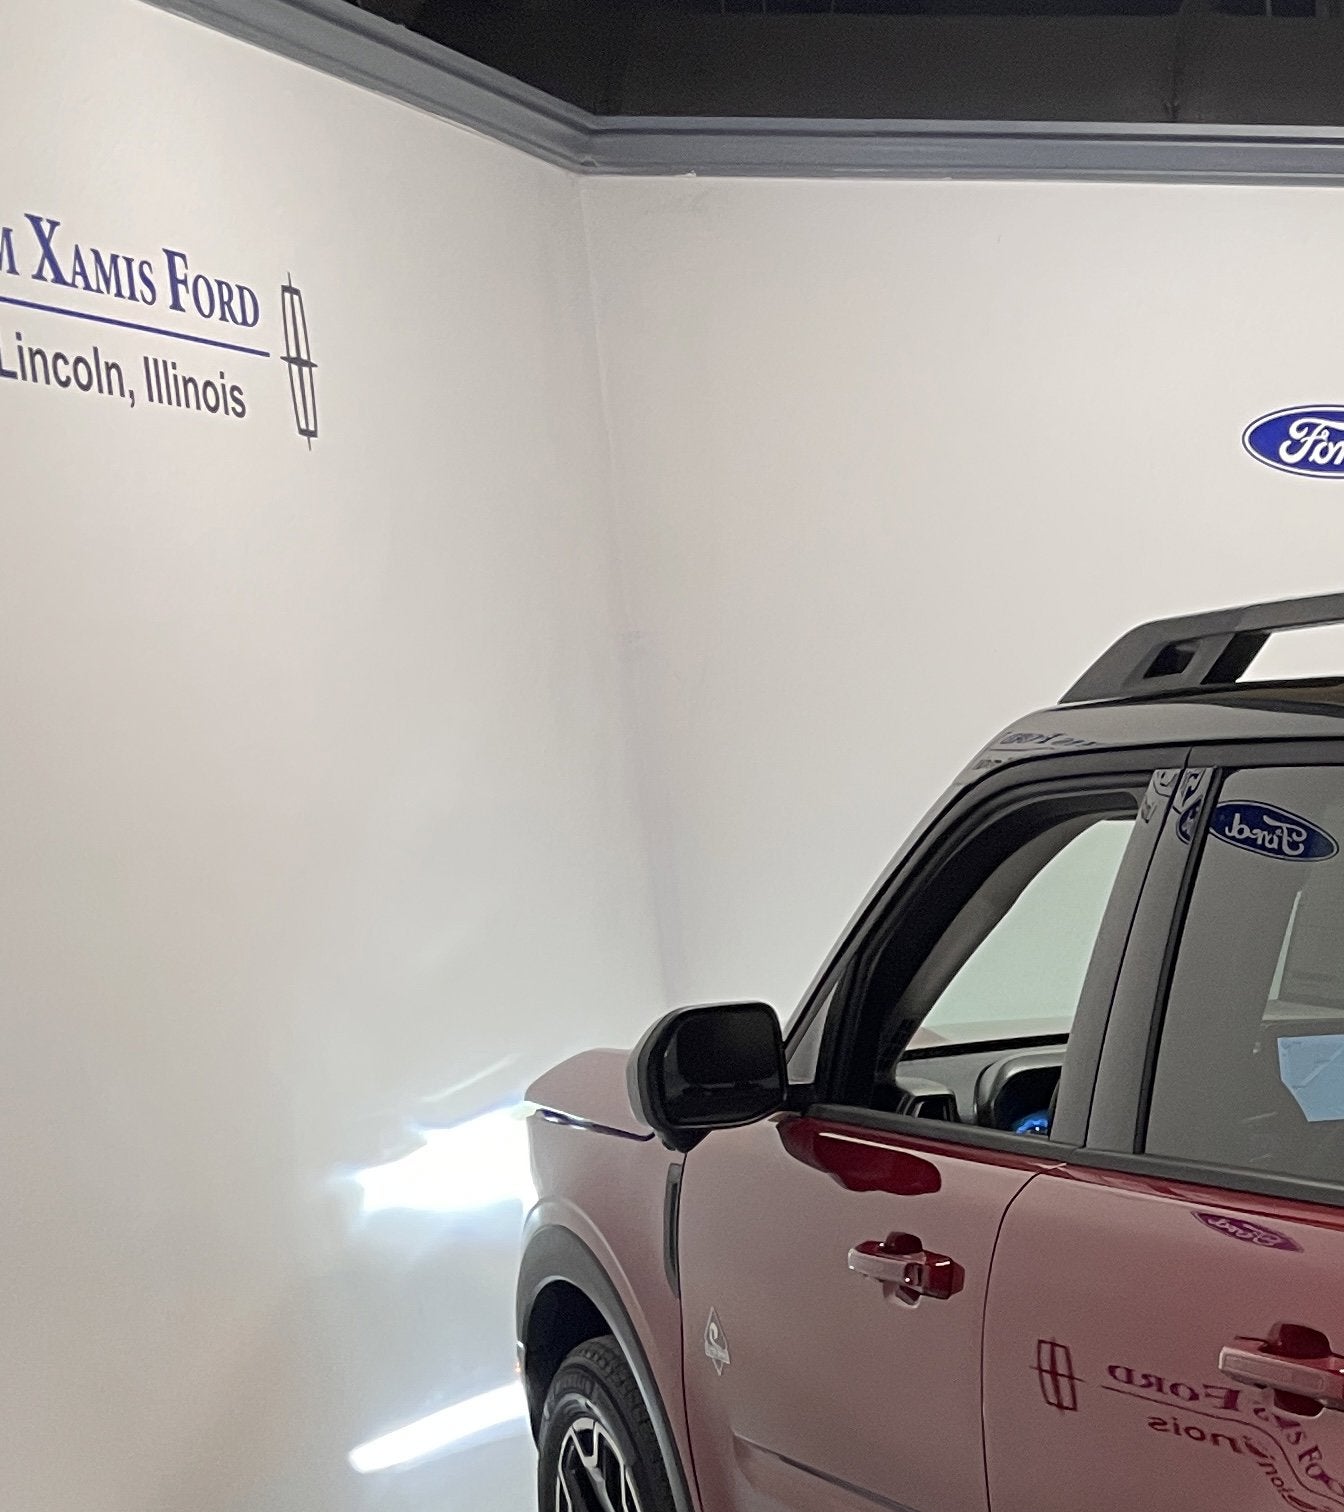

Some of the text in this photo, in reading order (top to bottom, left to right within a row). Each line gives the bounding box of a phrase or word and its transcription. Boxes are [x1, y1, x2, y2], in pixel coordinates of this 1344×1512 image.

[24, 212, 157, 306] XAMIS
[161, 247, 261, 328] FORD
[143, 355, 248, 419] Illinois
